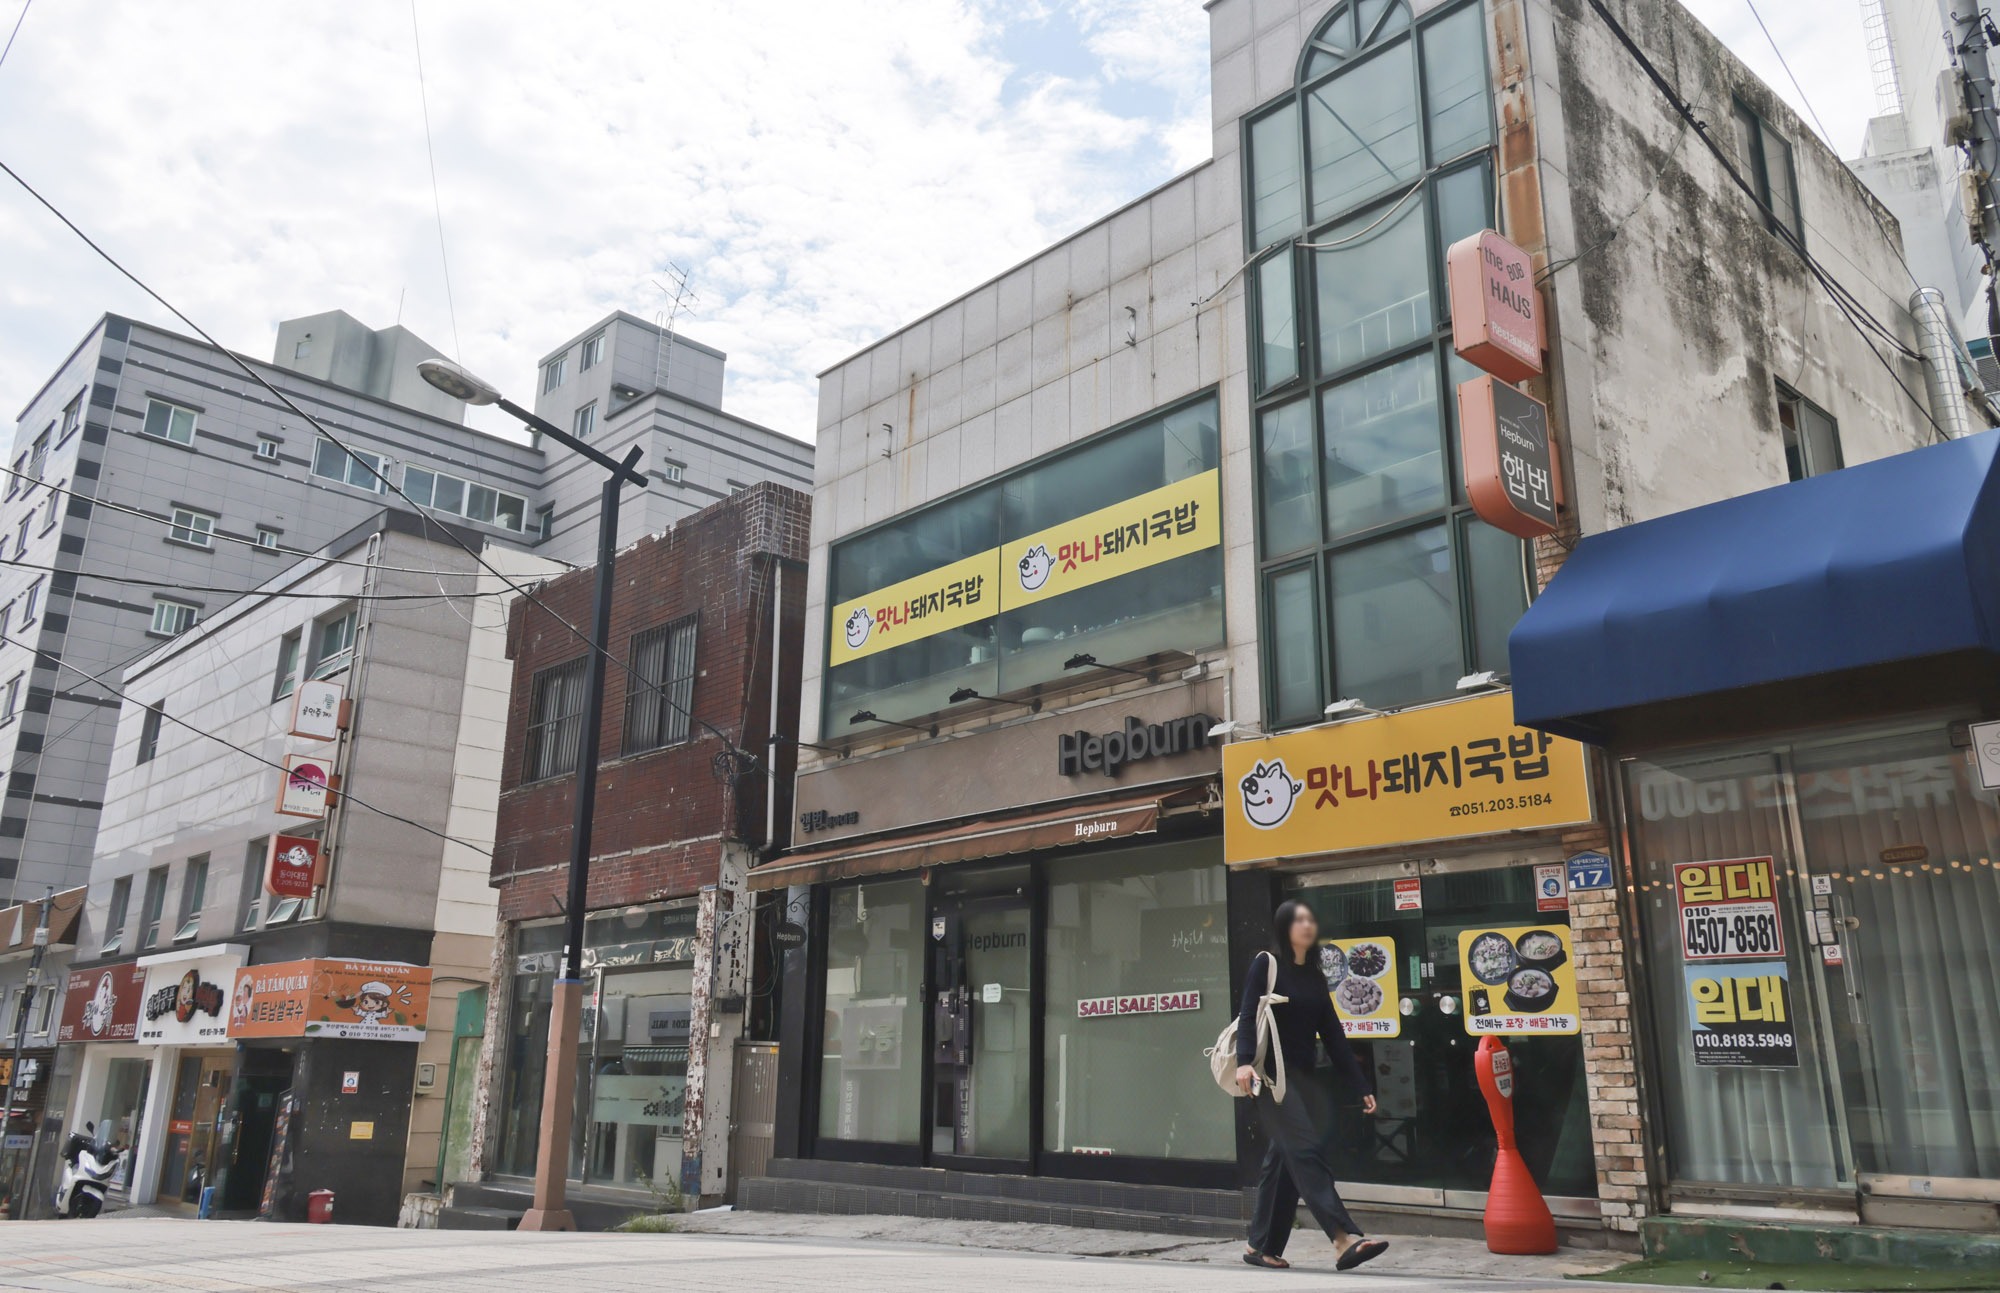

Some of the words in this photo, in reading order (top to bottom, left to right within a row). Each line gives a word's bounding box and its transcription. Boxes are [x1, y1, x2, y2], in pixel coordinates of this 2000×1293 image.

[1485, 246, 1503, 271] the
[1507, 262, 1525, 281] BOB
[1490, 277, 1531, 320] HAUS
[1491, 320, 1535, 358] Restaurant
[1501, 424, 1534, 452] Hepburn
[1502, 451, 1551, 511] 햅번
[1058, 500, 1199, 574] 맛나돼지국밥
[876, 575, 983, 634] 맛나돼지국밥
[1059, 713, 1213, 777] Hepburn
[1307, 730, 1553, 810] 맛나돼지국밥
[1462, 793, 1552, 815] 051.203.5184
[1075, 821, 1117, 837] Hepburn
[1574, 870, 1603, 886] 17
[1680, 861, 1773, 903] 임대
[1684, 906, 1716, 918] 010-
[776, 932, 801, 943] Hepburn
[1687, 914, 1779, 955] 4507-8581
[285, 970, 309, 995] QUÁN
[383, 965, 410, 975] QUÁN
[252, 999, 304, 1022] 베트남쌀국수
[1079, 999, 1115, 1016] SALE
[1118, 997, 1156, 1013] SALE
[1159, 993, 1199, 1010] SALE
[1691, 975, 1786, 1023] 임대
[1475, 1018, 1503, 1029] 전메뉴
[1696, 1033, 1793, 1048] 010.8183.5949
